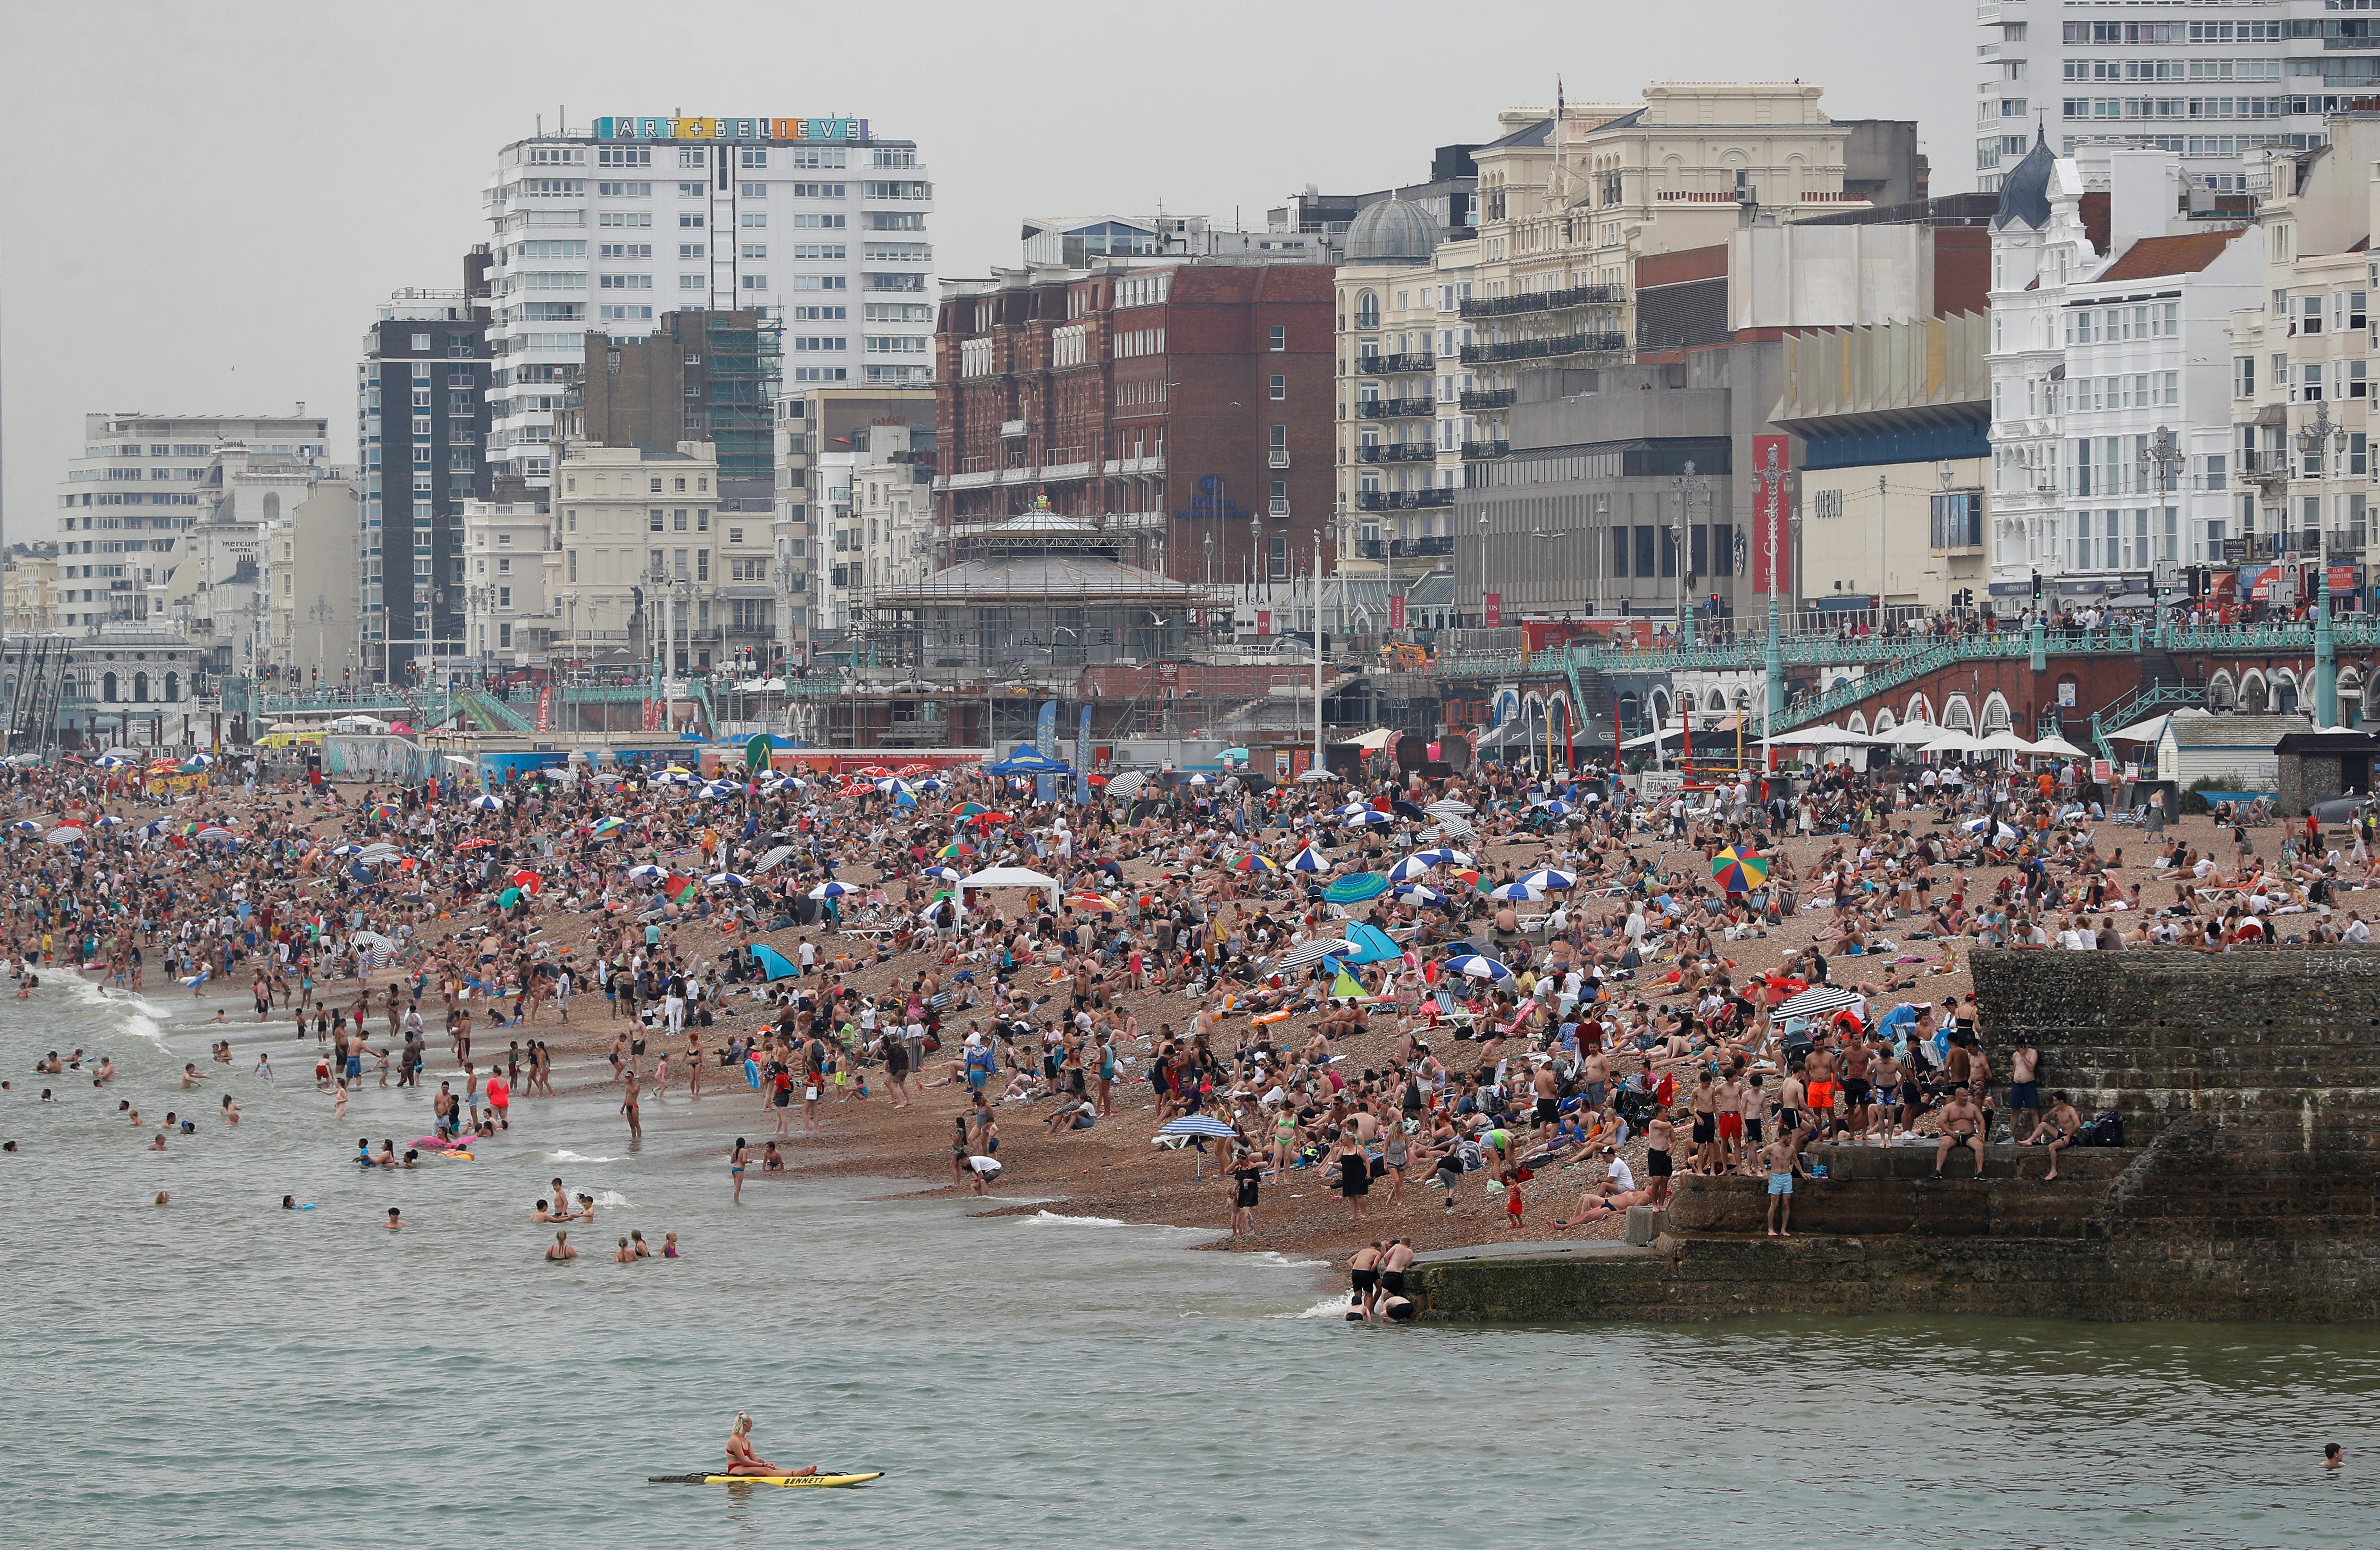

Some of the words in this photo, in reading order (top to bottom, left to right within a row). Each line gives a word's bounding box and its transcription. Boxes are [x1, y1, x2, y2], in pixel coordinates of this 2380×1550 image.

[1190, 495, 1234, 508] Hilton
[1815, 489, 1842, 517] ODEON
[1646, 782, 1665, 792] BEACH
